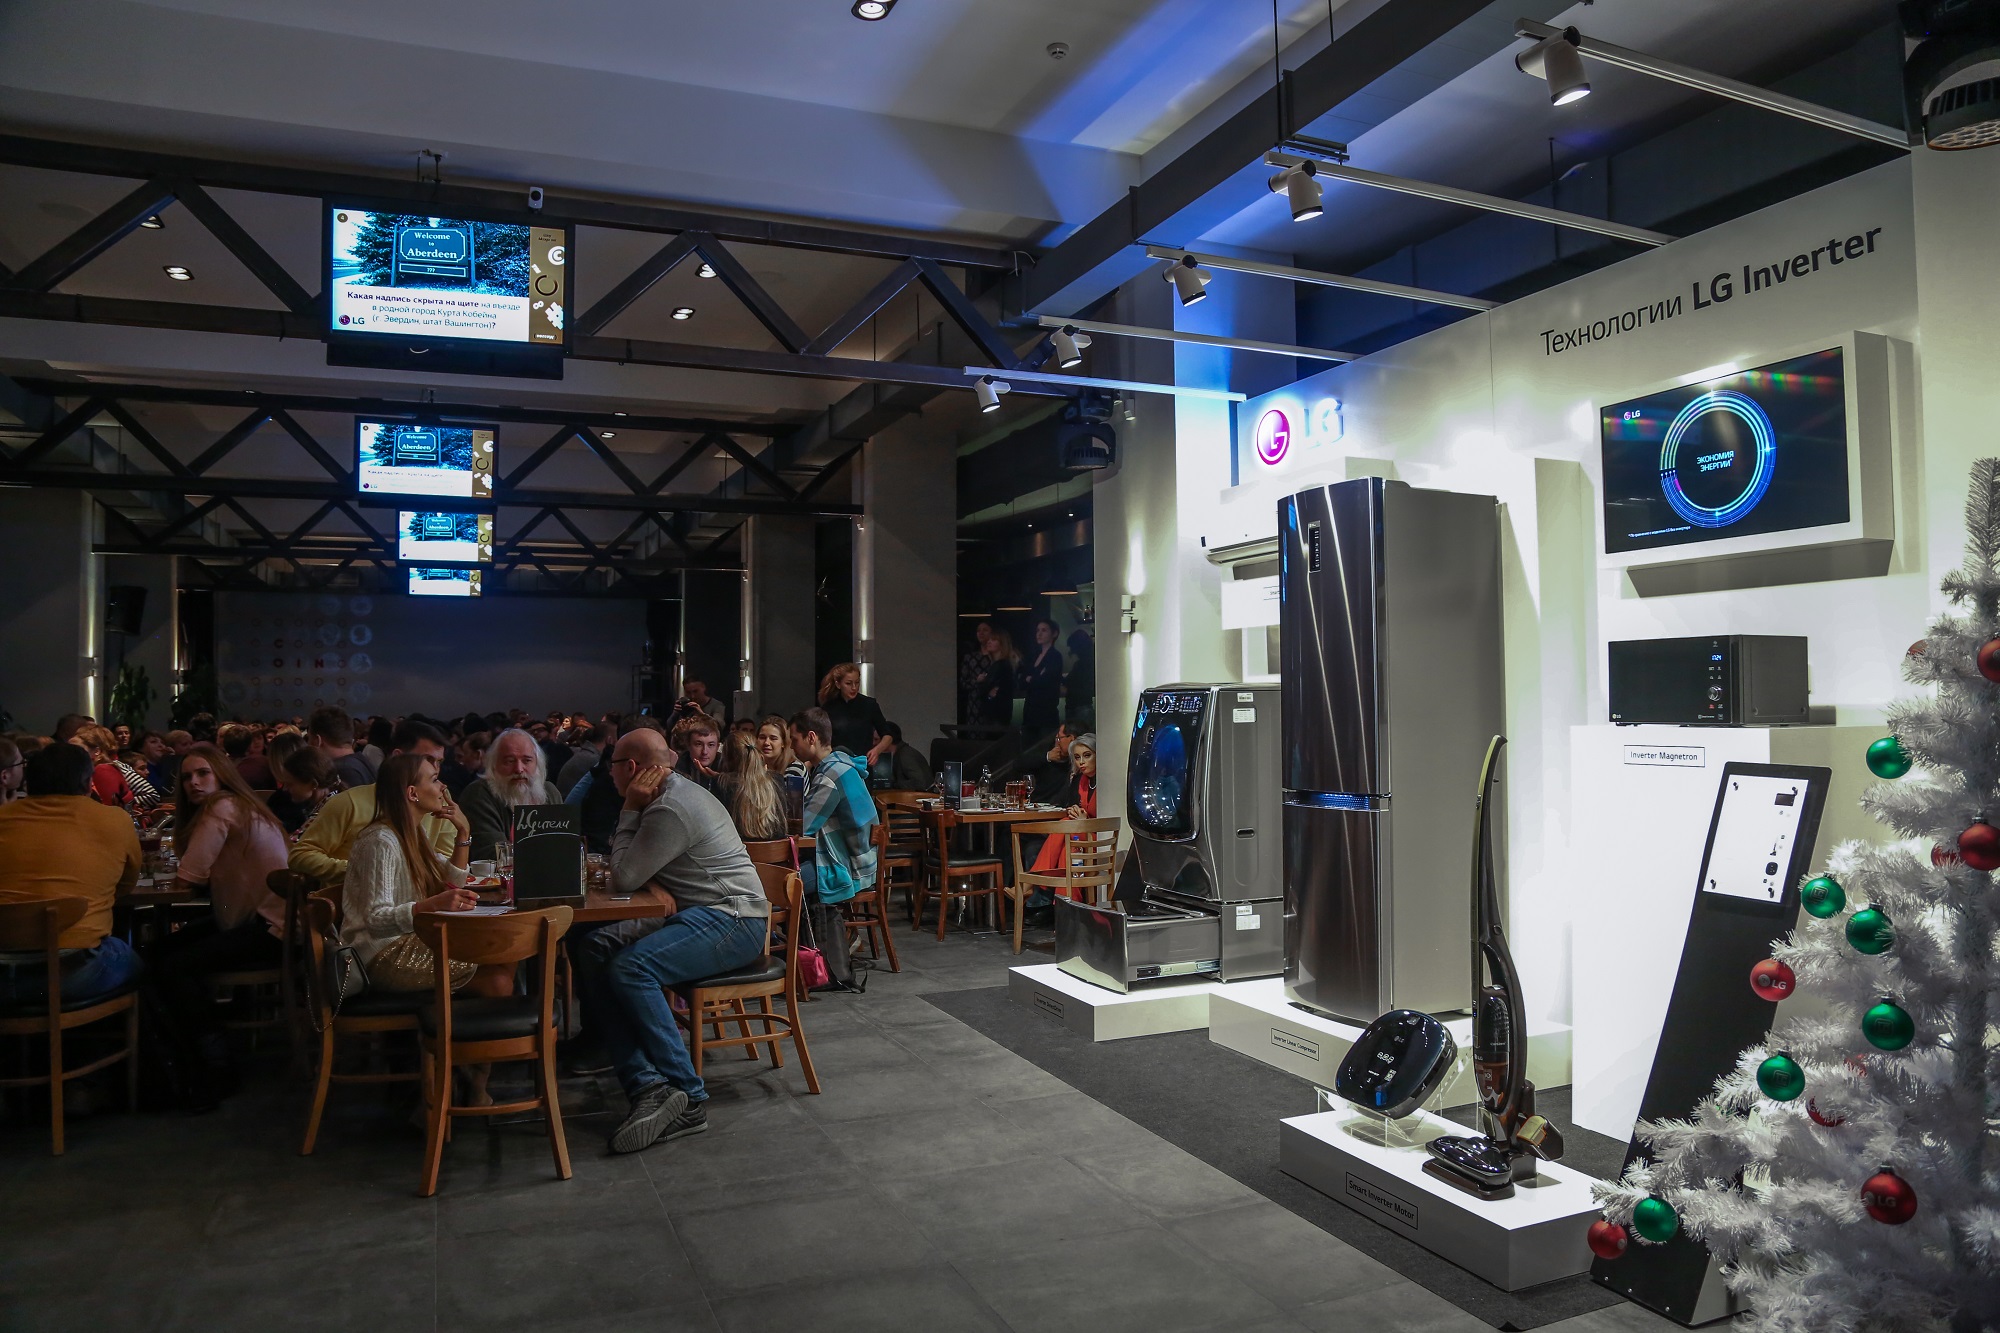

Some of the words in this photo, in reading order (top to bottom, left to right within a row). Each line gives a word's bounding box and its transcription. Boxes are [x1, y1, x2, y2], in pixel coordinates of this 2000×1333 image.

[414, 231, 450, 240] Welcome
[406, 247, 458, 260] Aberdeen
[1540, 295, 1682, 356] Технологии
[1693, 272, 1733, 311] LG
[1744, 227, 1882, 295] Inverter
[347, 291, 374, 300] Какая
[375, 294, 411, 304] надпись
[413, 296, 444, 306] скрыта
[457, 300, 479, 309] щите
[379, 304, 410, 315] родной
[411, 306, 436, 316] город
[437, 309, 461, 319] Курта
[462, 310, 497, 320] Кобейна
[352, 316, 365, 325] LG
[423, 318, 442, 326] штат
[1631, 410, 1641, 419] LG
[1696, 450, 1735, 465] ЭКОНОМИЯ
[1630, 750, 1657, 760] Inverter
[1659, 751, 1698, 763] Magnetron
[1771, 979, 1787, 990] LG
[1348, 1180, 1368, 1197] Smart
[1368, 1189, 1393, 1209] Inverter
[1394, 1202, 1415, 1220] Motor
[1877, 1195, 1897, 1208] LG
